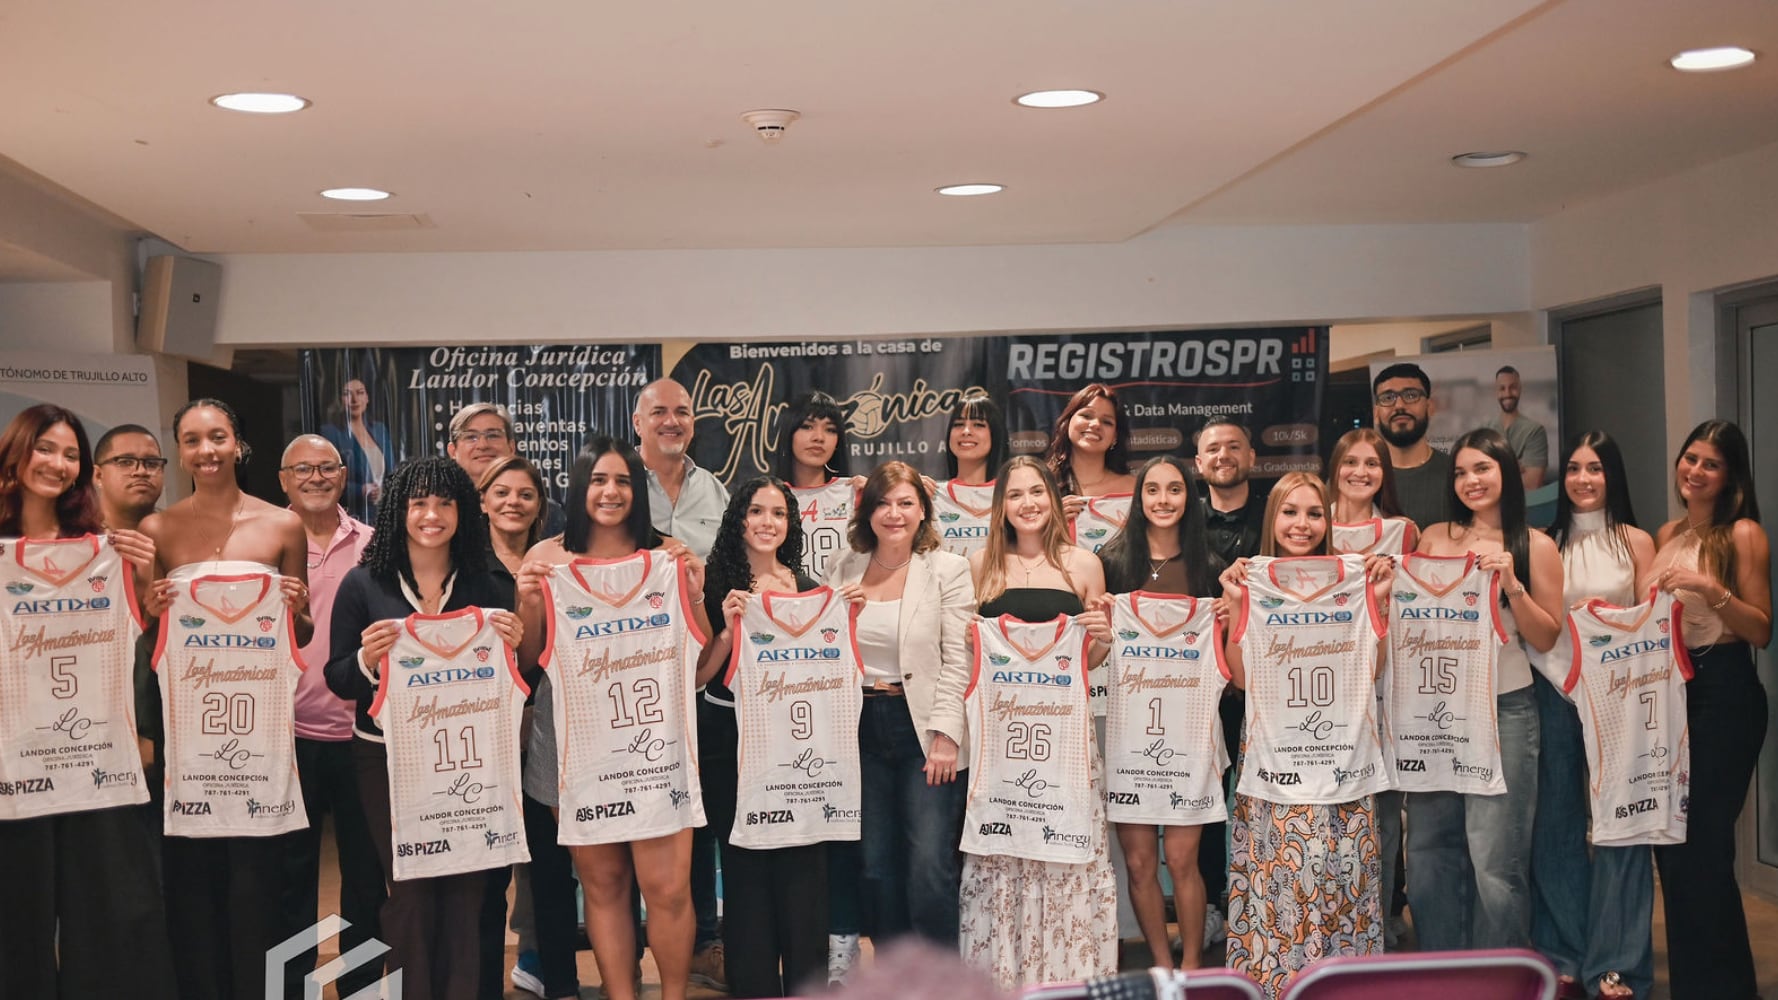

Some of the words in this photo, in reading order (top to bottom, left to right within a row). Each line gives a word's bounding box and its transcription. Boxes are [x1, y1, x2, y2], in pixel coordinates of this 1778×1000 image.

[429, 346, 518, 371] Oficina
[524, 345, 626, 367] Jurídica
[730, 341, 838, 359] Bienvenidos
[841, 344, 853, 355] a
[856, 342, 874, 355] la
[877, 343, 916, 354] casa
[920, 340, 942, 352] de
[1007, 338, 1283, 380] REGISTROSPR
[53, 370, 68, 380] DE
[70, 371, 119, 381] TRUJILLO
[122, 372, 148, 382] ALTO
[408, 369, 498, 390] Landor
[507, 367, 648, 392] Concepción
[691, 369, 750, 421] Las
[1134, 403, 1165, 416] Data
[1168, 401, 1253, 416] Management
[514, 419, 586, 433] aventas
[1273, 430, 1307, 441] 10k/5k
[851, 440, 929, 457] RUJILLO
[1264, 461, 1320, 474] Graduandas
[944, 526, 989, 538] ARTI
[51, 655, 78, 699] 5
[1287, 666, 1335, 708] 10
[1418, 656, 1458, 695] 15
[202, 692, 255, 735] 20
[608, 677, 664, 729] 12
[1639, 690, 1658, 730] 7
[791, 700, 813, 740] 9
[1146, 697, 1165, 735] 1
[20, 748, 57, 758] LANDOR
[433, 725, 483, 773] 11
[1006, 721, 1051, 761] 26
[599, 770, 634, 782] LANDOR
[636, 762, 680, 776] CONCEPCIÓ
[989, 797, 1017, 806] LANDOR
[419, 811, 452, 822] LANDOR
